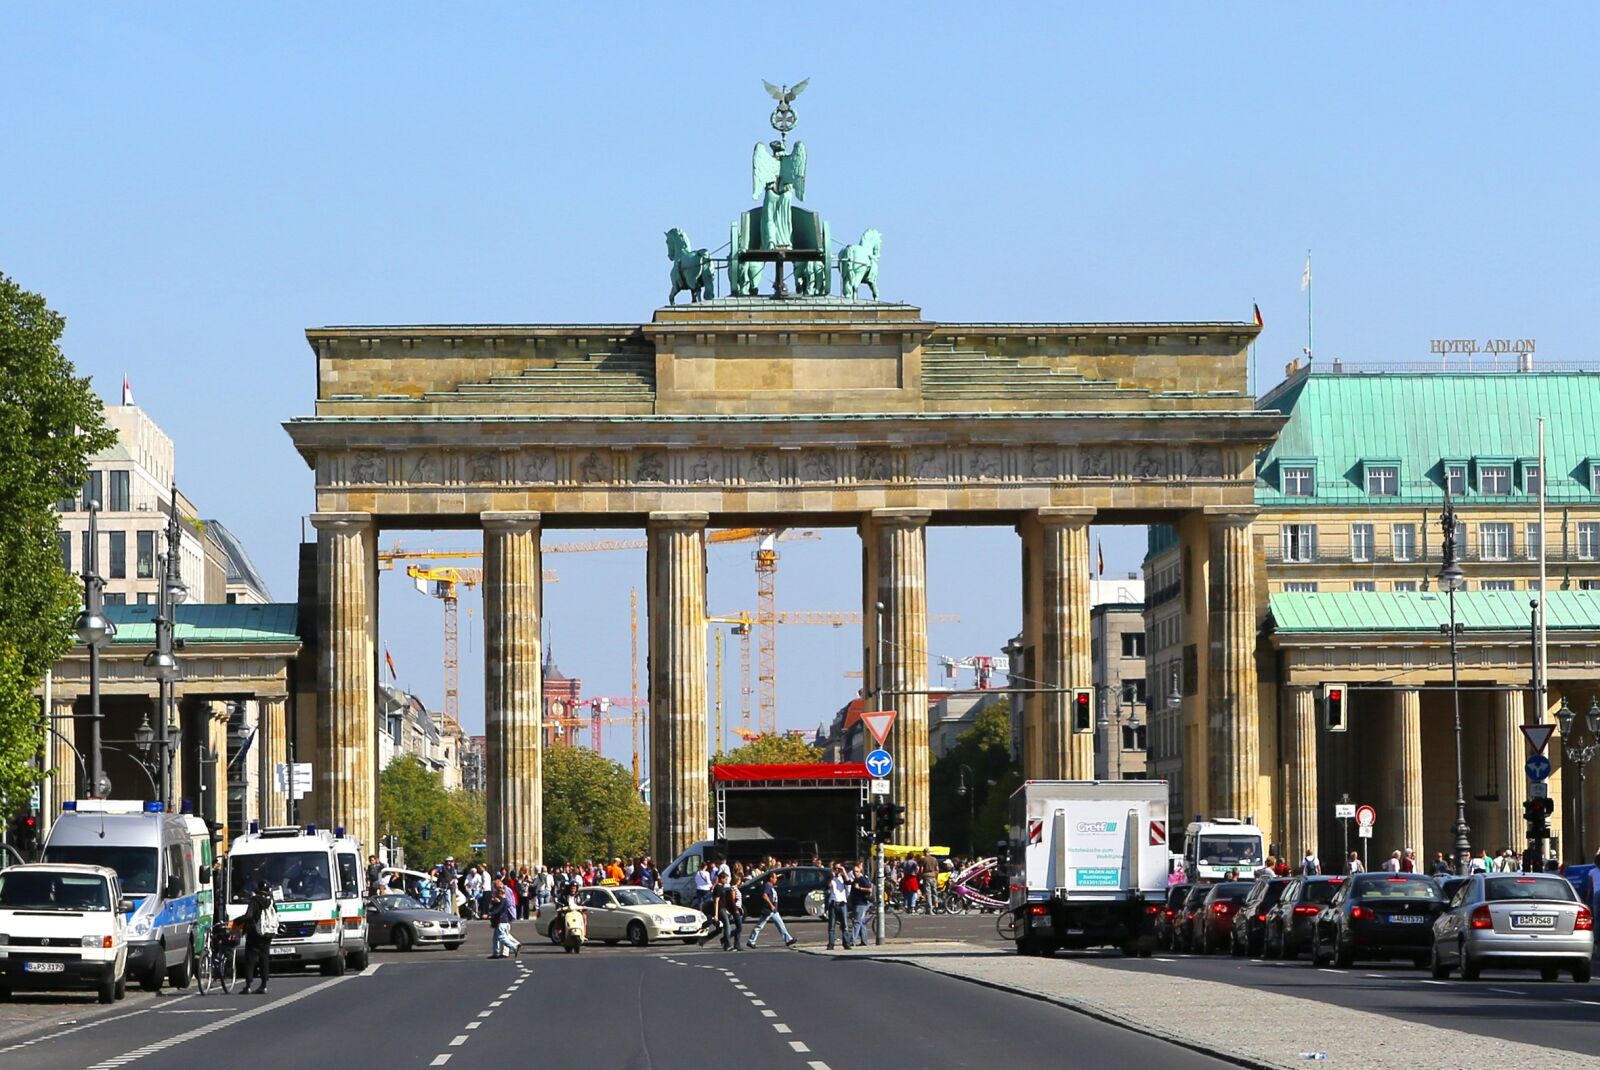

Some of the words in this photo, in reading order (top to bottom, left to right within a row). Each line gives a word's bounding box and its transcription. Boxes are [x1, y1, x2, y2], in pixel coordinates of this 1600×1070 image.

[1430, 339, 1480, 353] HOTEL
[1482, 339, 1536, 353] ADLON
[1076, 822, 1107, 832] Greif
